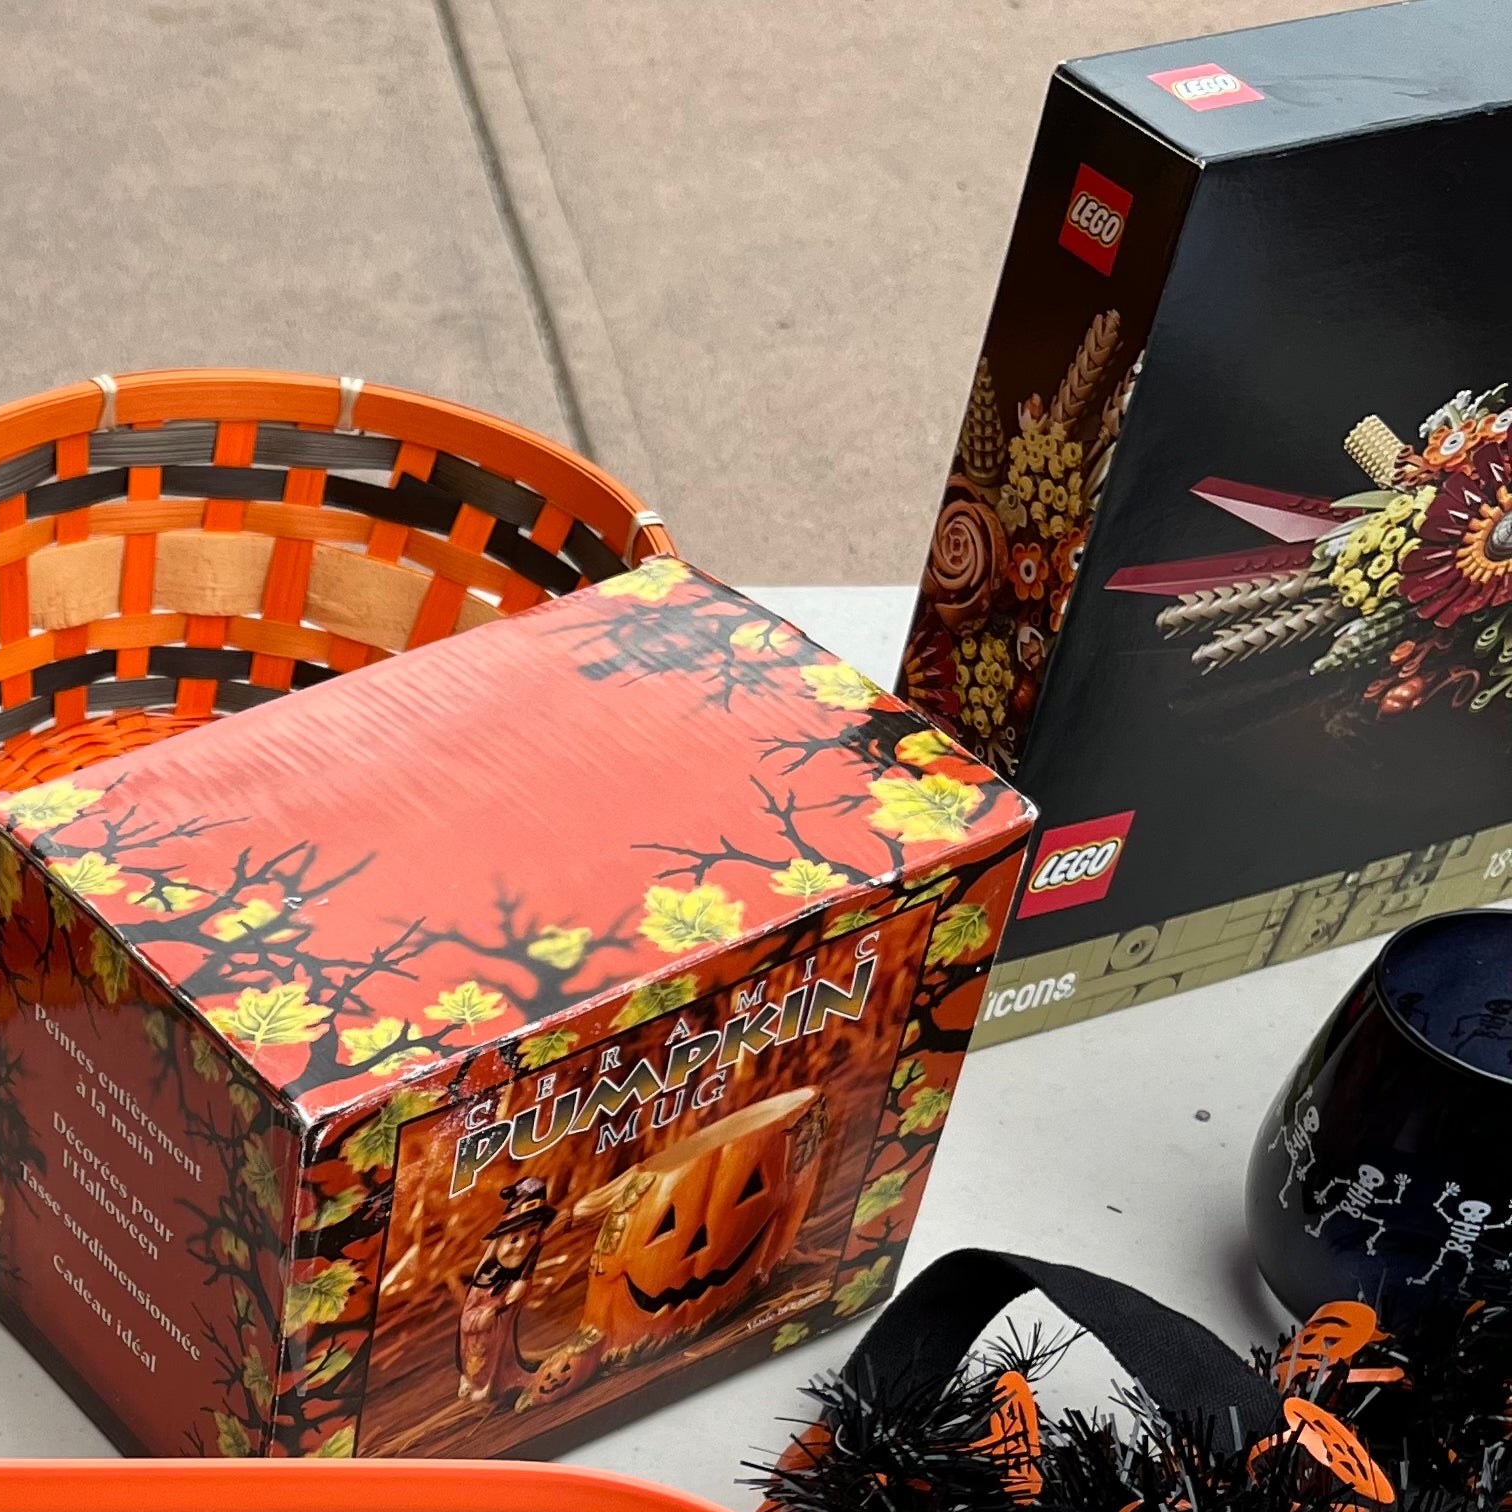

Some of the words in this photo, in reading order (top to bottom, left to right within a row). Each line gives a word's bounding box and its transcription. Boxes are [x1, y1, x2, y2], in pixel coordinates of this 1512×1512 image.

[1174, 73, 1239, 101] LEGO
[1070, 193, 1121, 245] LEGO
[1033, 837, 1119, 891] LEGO
[983, 971, 1077, 1022] icons
[34, 1003, 94, 1076] Peintes
[98, 1066, 203, 1183] entièrement
[75, 1074, 88, 1099] à
[90, 1089, 107, 1119] la
[110, 1114, 154, 1166] main
[449, 956, 879, 1199] PUMPKIN
[595, 1070, 727, 1155] MUG
[53, 1111, 129, 1196] Décorées
[132, 1189, 175, 1243] pour
[62, 1149, 159, 1261] l'Halloween
[19, 1161, 62, 1217] Tasse
[63, 1208, 202, 1362] surdimensionnée
[52, 1254, 112, 1327] Cadeau
[116, 1319, 157, 1373] idéal
